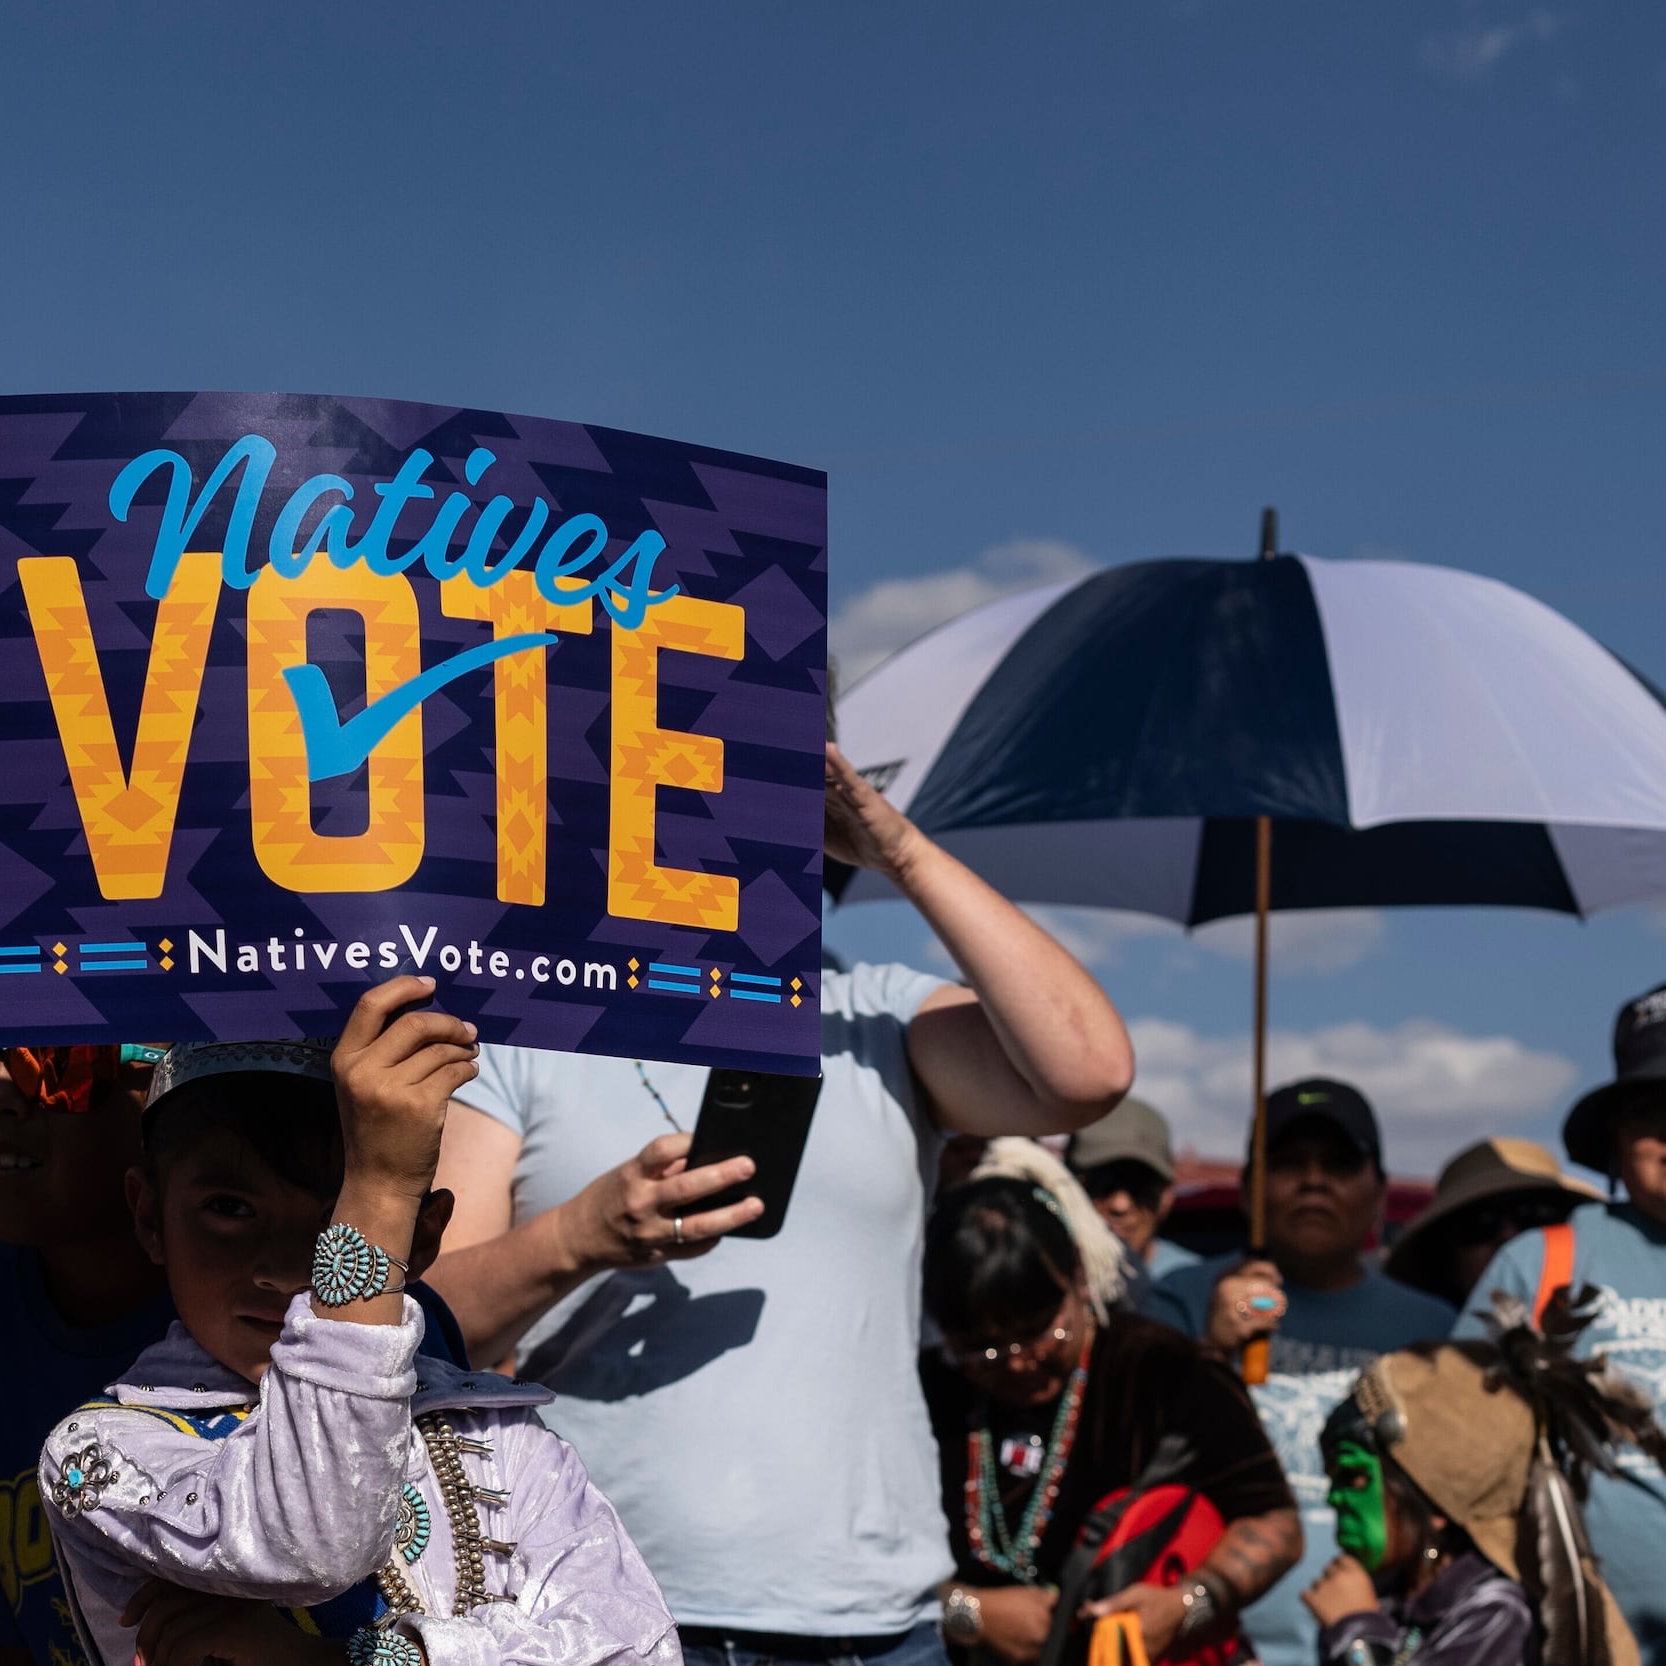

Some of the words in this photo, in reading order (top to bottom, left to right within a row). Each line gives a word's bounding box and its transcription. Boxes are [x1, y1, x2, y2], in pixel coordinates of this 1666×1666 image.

[108, 433, 681, 630] Natives
[17, 552, 745, 933] VOTE
[188, 924, 618, 991] NativesVote.com
